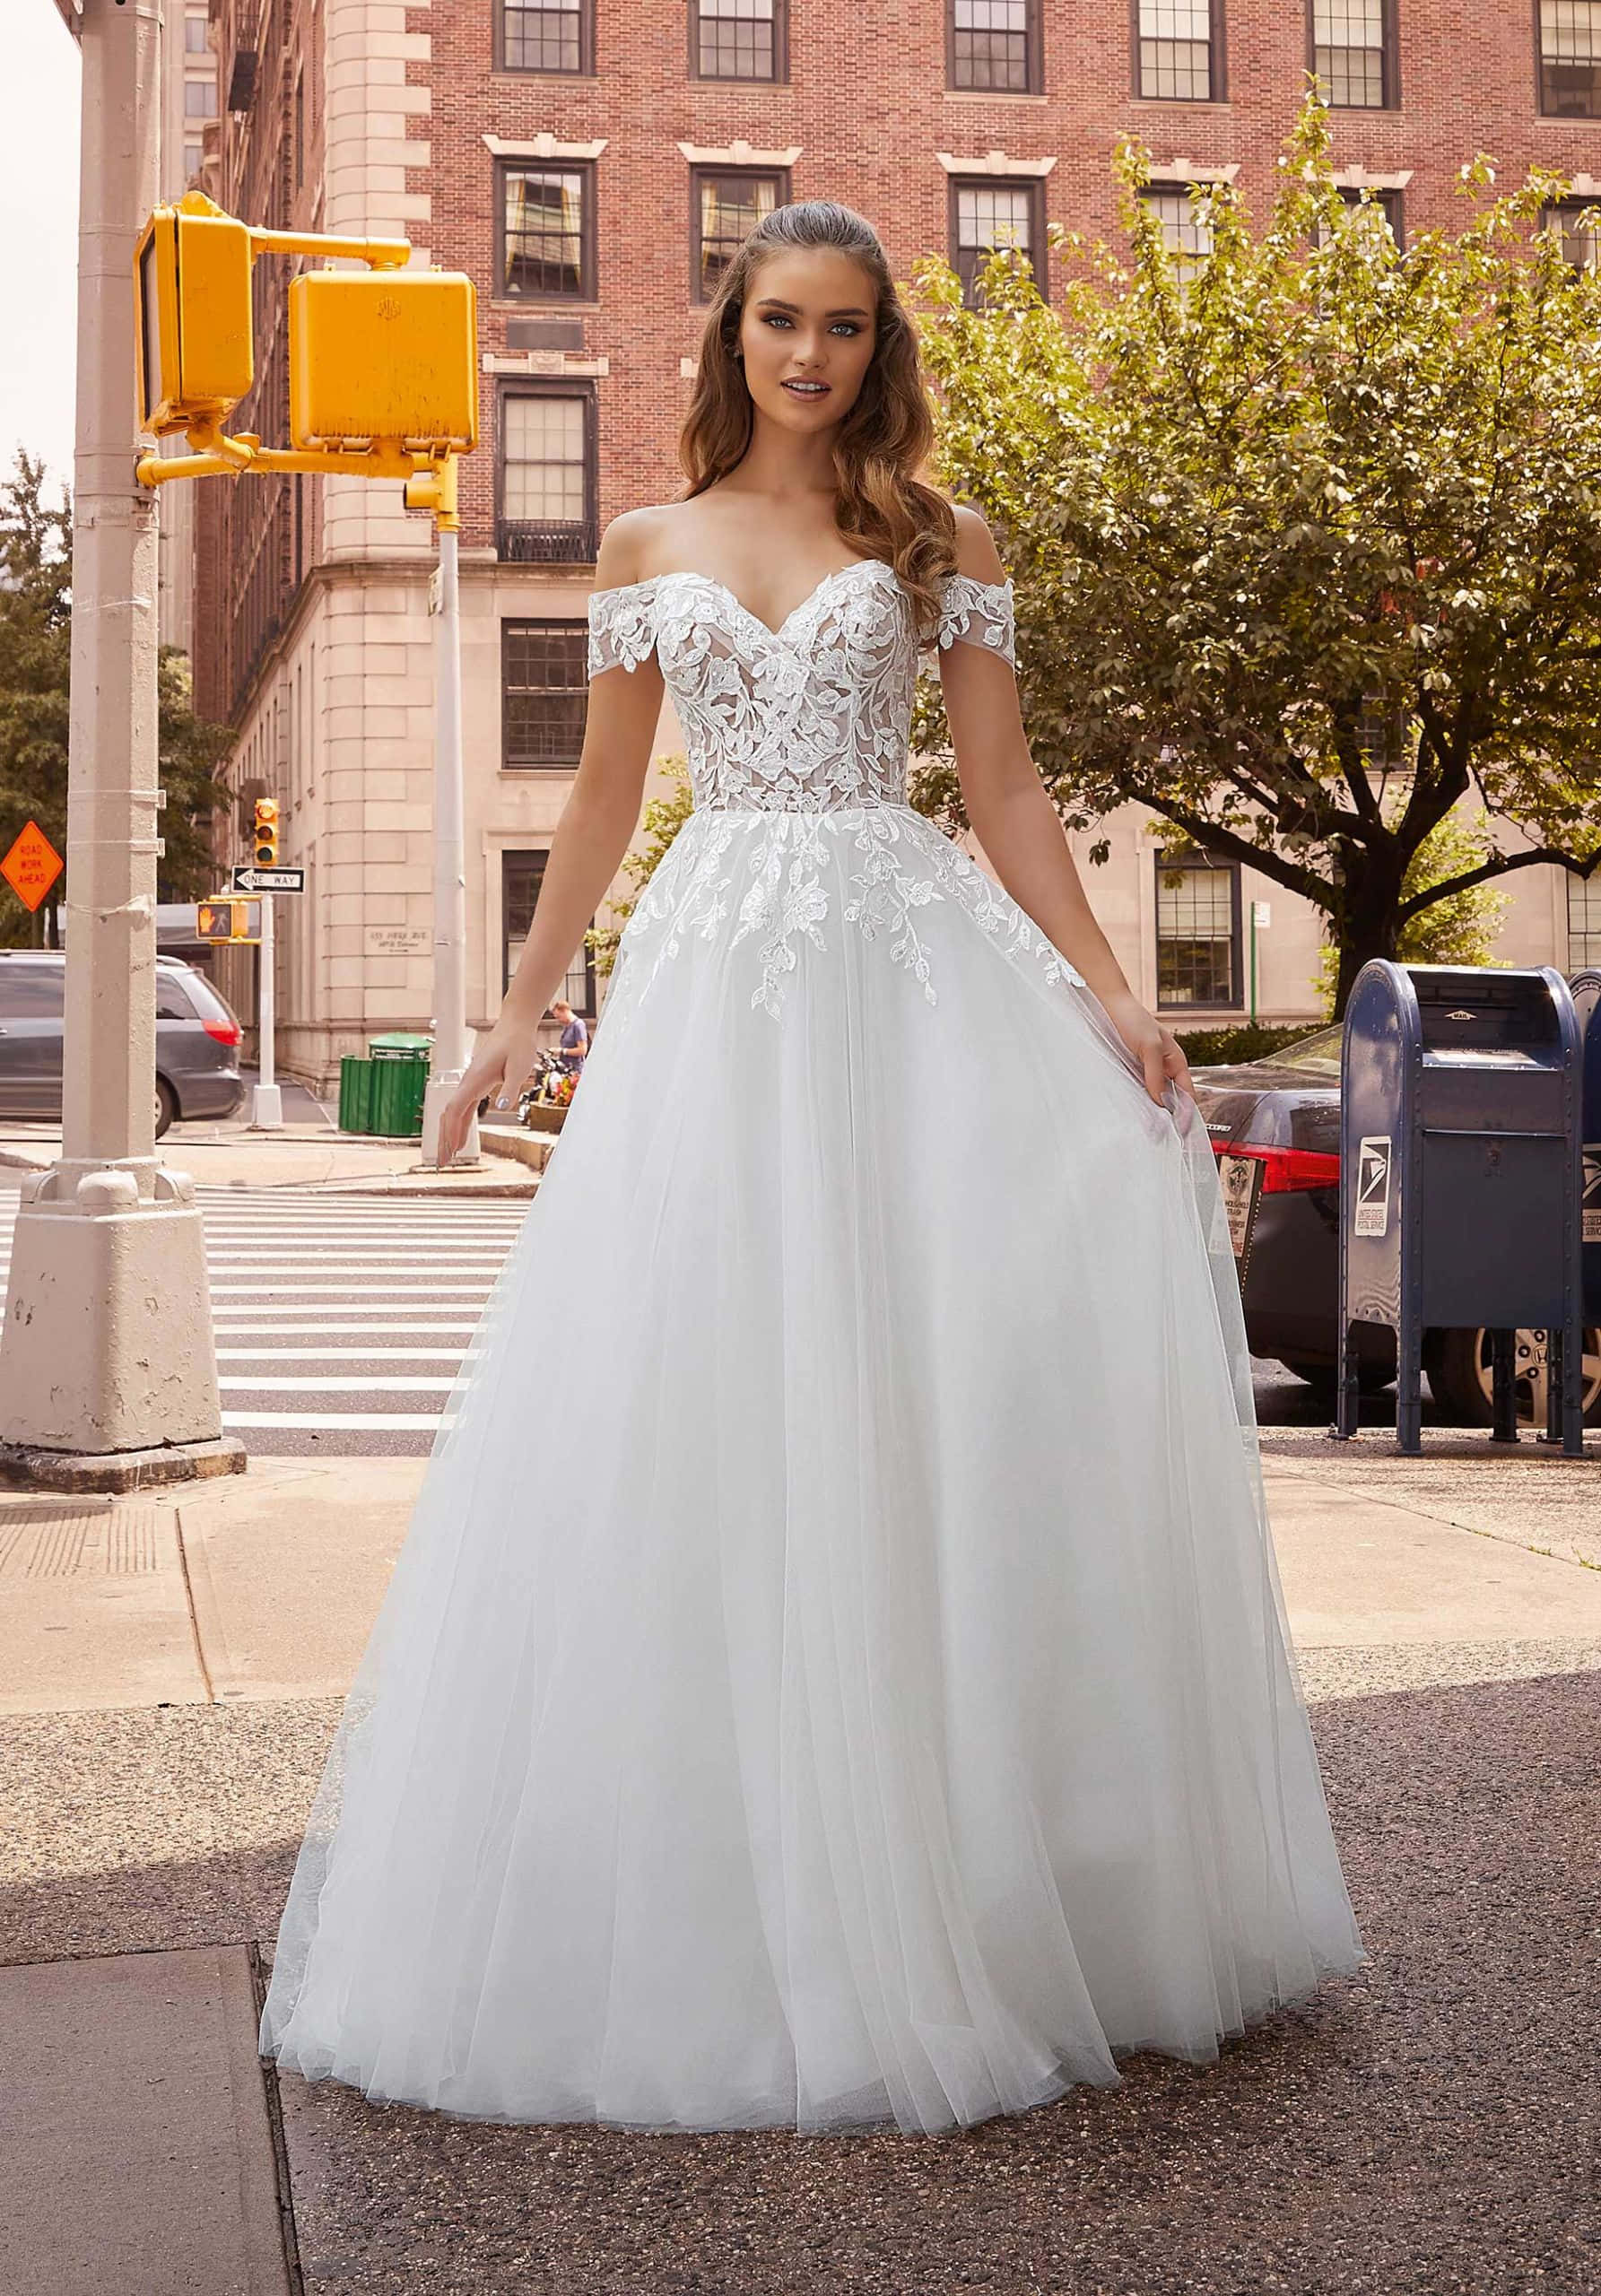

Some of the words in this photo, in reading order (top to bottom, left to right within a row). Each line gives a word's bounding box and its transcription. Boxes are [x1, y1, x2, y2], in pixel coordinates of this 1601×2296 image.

[21, 845, 42, 855] ROAD
[21, 860, 41, 869] WORK
[19, 874, 45, 883] AHEAD
[244, 874, 265, 884] ONE
[274, 875, 295, 884] WAY
